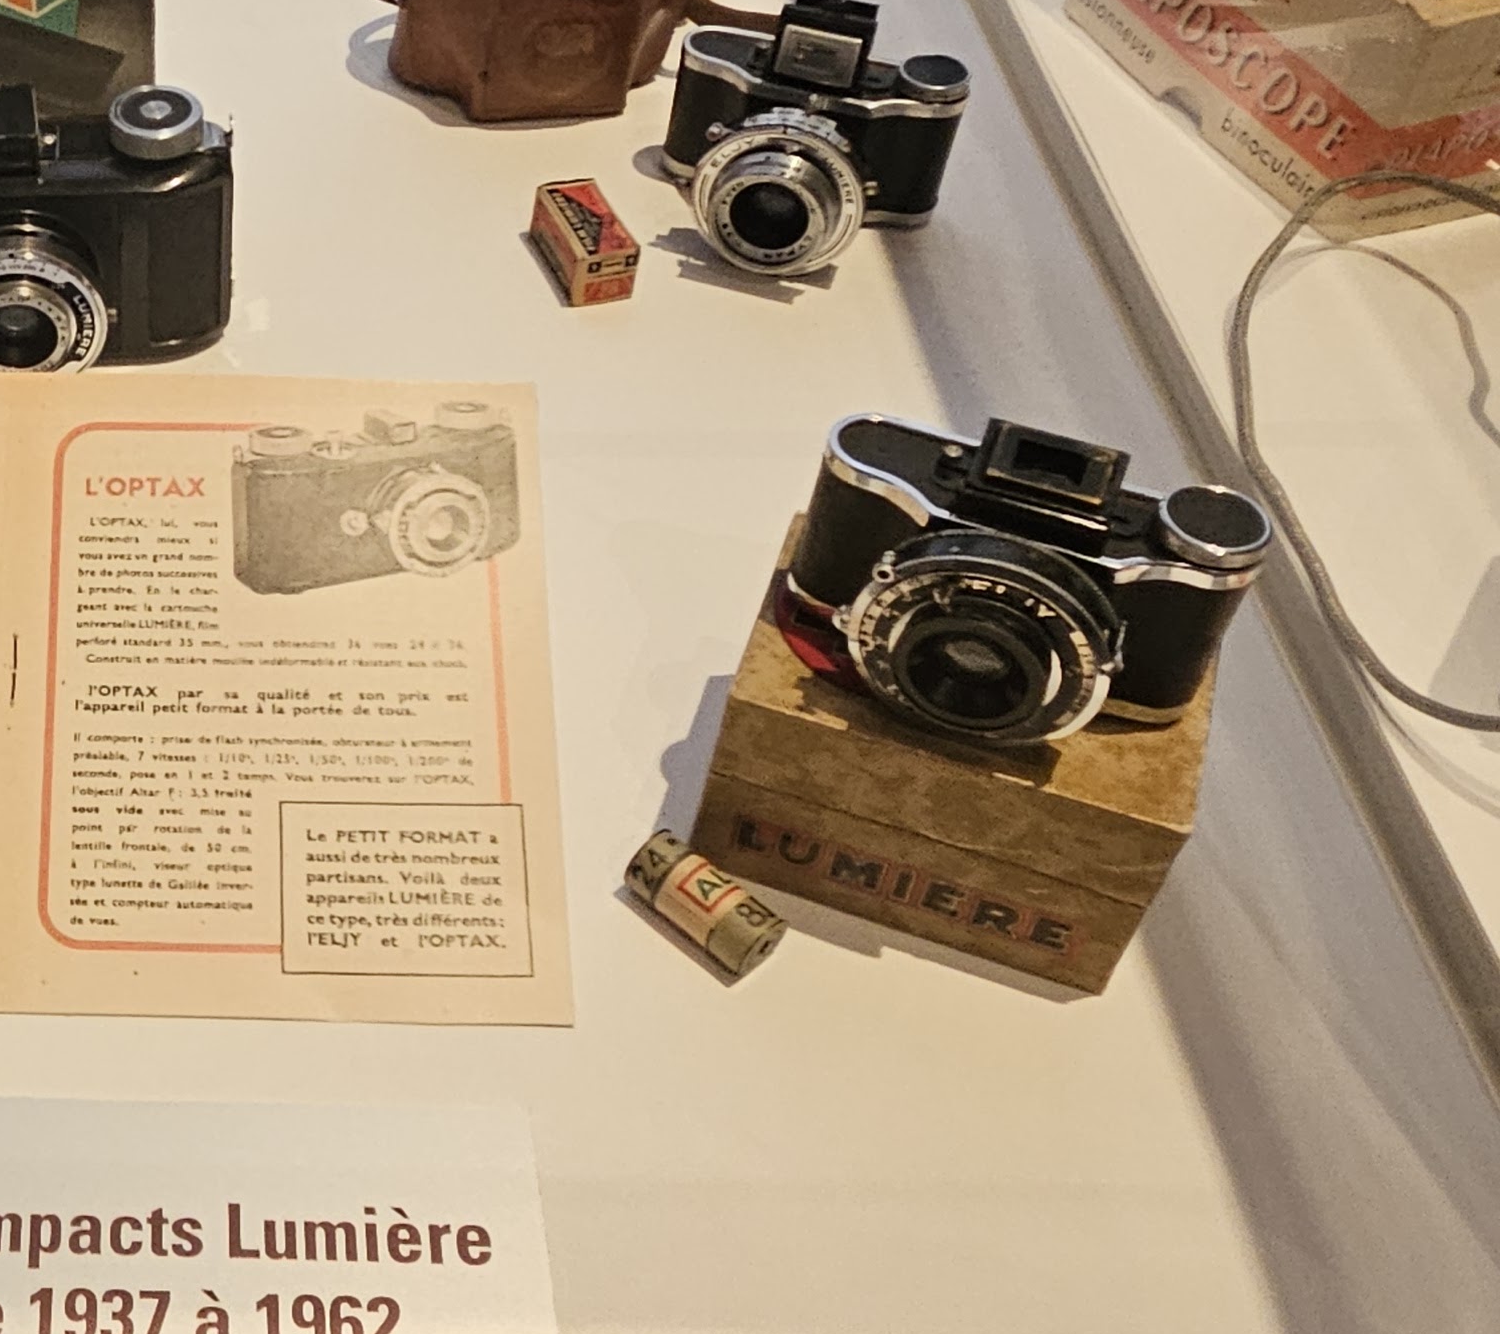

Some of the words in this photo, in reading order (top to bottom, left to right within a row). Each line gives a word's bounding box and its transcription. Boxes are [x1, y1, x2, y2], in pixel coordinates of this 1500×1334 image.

[1221, 107, 1316, 199] binoculair
[72, 294, 95, 358] LUMIERE
[84, 476, 204, 498] L'OPTAX
[88, 684, 157, 697] l'OPTAX
[306, 829, 326, 841] Le
[335, 829, 389, 843] PETIT
[398, 829, 480, 844] FORMAT
[489, 835, 497, 843] a
[305, 850, 346, 862] aussi
[350, 850, 370, 862] de
[374, 851, 407, 863] très
[411, 851, 499, 864] nombreux
[306, 870, 387, 887] partisans.
[400, 871, 444, 888] Voilà
[460, 872, 501, 885] deux
[736, 818, 1074, 950] LUMIERE
[388, 890, 474, 905] LUMIÈRE
[481, 893, 502, 905] de
[306, 915, 325, 924] ce
[328, 914, 371, 928] type,
[375, 913, 408, 926] très
[307, 931, 361, 948] l'ELJY
[380, 936, 397, 947] et
[418, 933, 505, 948] l'OPTAX.
[227, 1202, 492, 1266] Lumière
